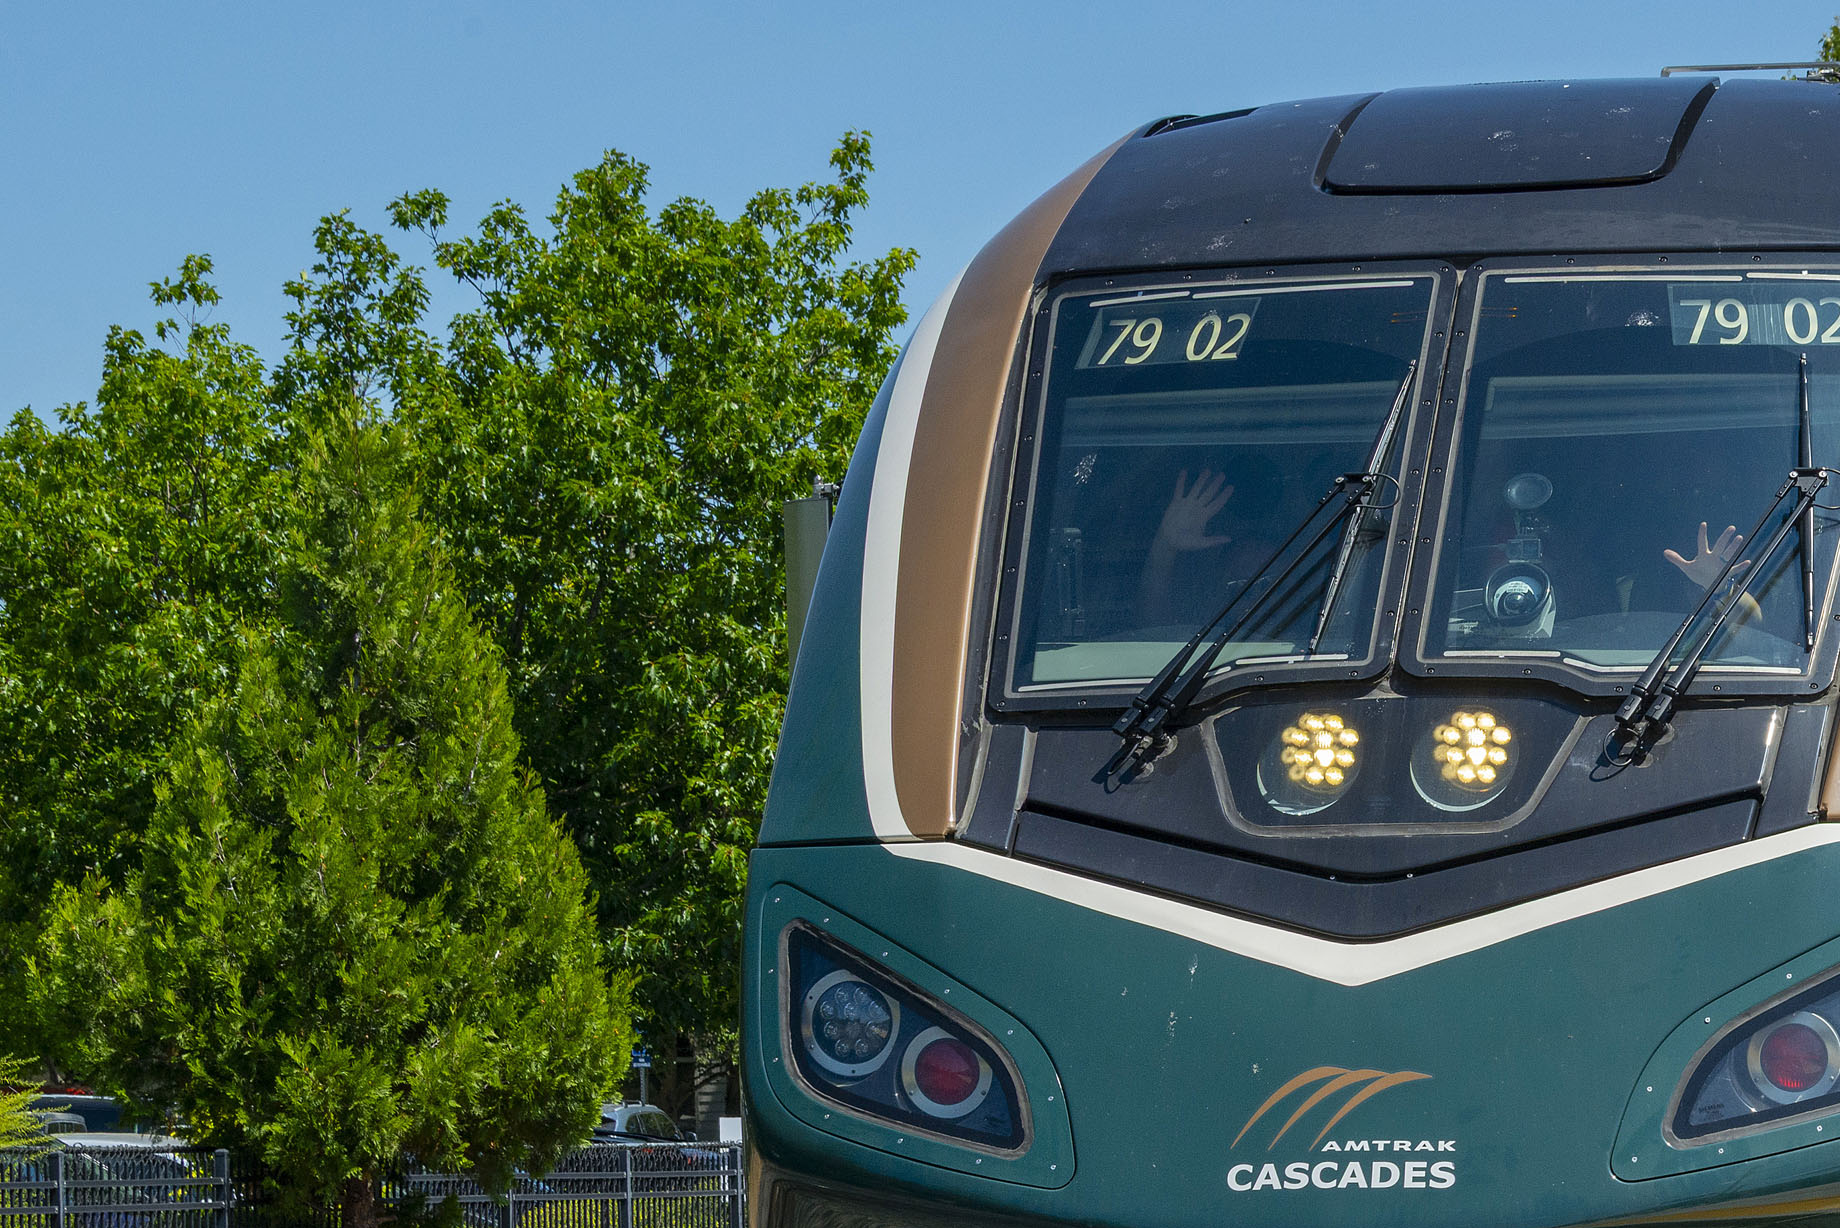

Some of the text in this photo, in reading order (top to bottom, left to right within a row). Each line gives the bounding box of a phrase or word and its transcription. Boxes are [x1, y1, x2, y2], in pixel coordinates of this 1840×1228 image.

[1098, 313, 1251, 365] 79 02
[1680, 298, 1749, 345] 79
[1321, 1140, 1456, 1152] AMTRAK
[1227, 1161, 1456, 1191] CASCADES
